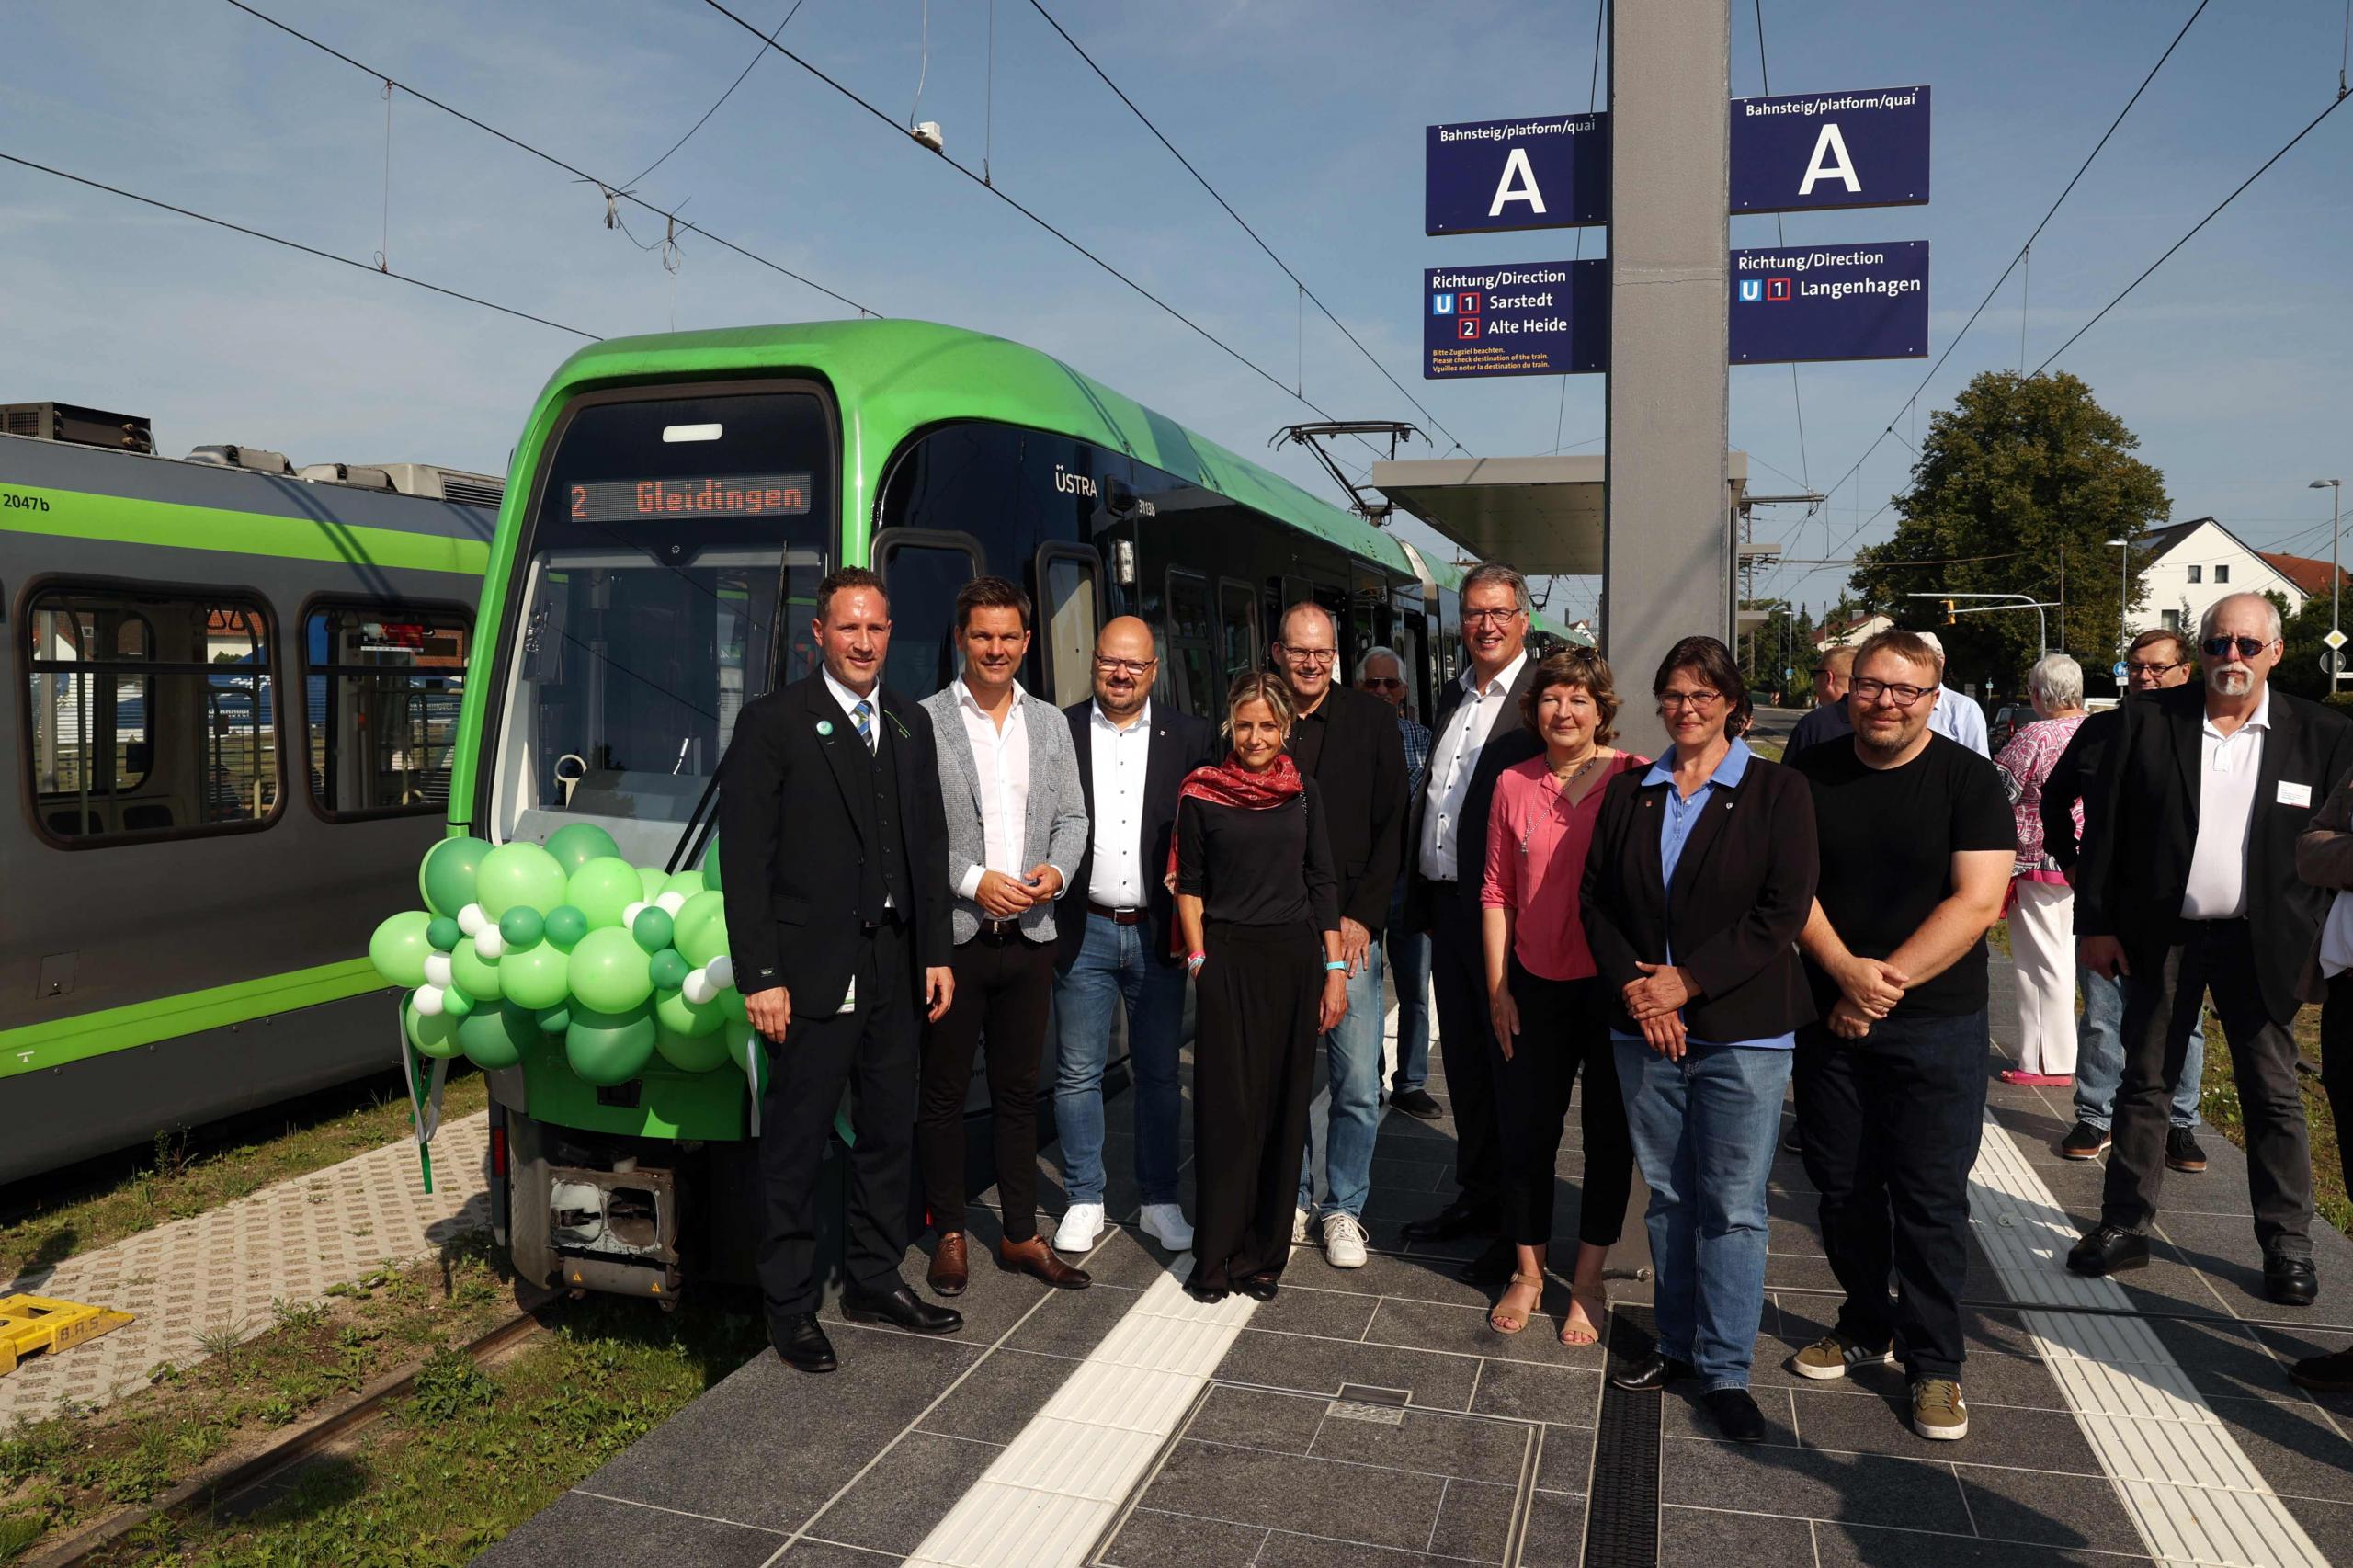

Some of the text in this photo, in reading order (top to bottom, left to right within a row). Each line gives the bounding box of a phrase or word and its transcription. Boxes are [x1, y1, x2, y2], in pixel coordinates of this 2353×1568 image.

[1745, 93, 1916, 117] Bahnsteig/platform/quai
[1439, 119, 1596, 142] Bahnsteig/platform/quai
[1799, 123, 1862, 196] A
[1488, 148, 1547, 217] A
[1738, 251, 1885, 272] Richtung/Direction
[1433, 270, 1566, 290] Richtung/Direction
[1742, 278, 1922, 301] U 1 Langenhagen
[1436, 292, 1553, 313] U 1 Sarstedt
[1463, 317, 1568, 336] 2 Alte Heide
[1449, 347, 1472, 357] Zugziel
[1454, 356, 1472, 364] check
[1472, 355, 1510, 363] destination
[1055, 464, 1098, 499] ÜSTRA
[3, 494, 50, 512] 2047b
[571, 479, 801, 518] 2 Gleidingen
